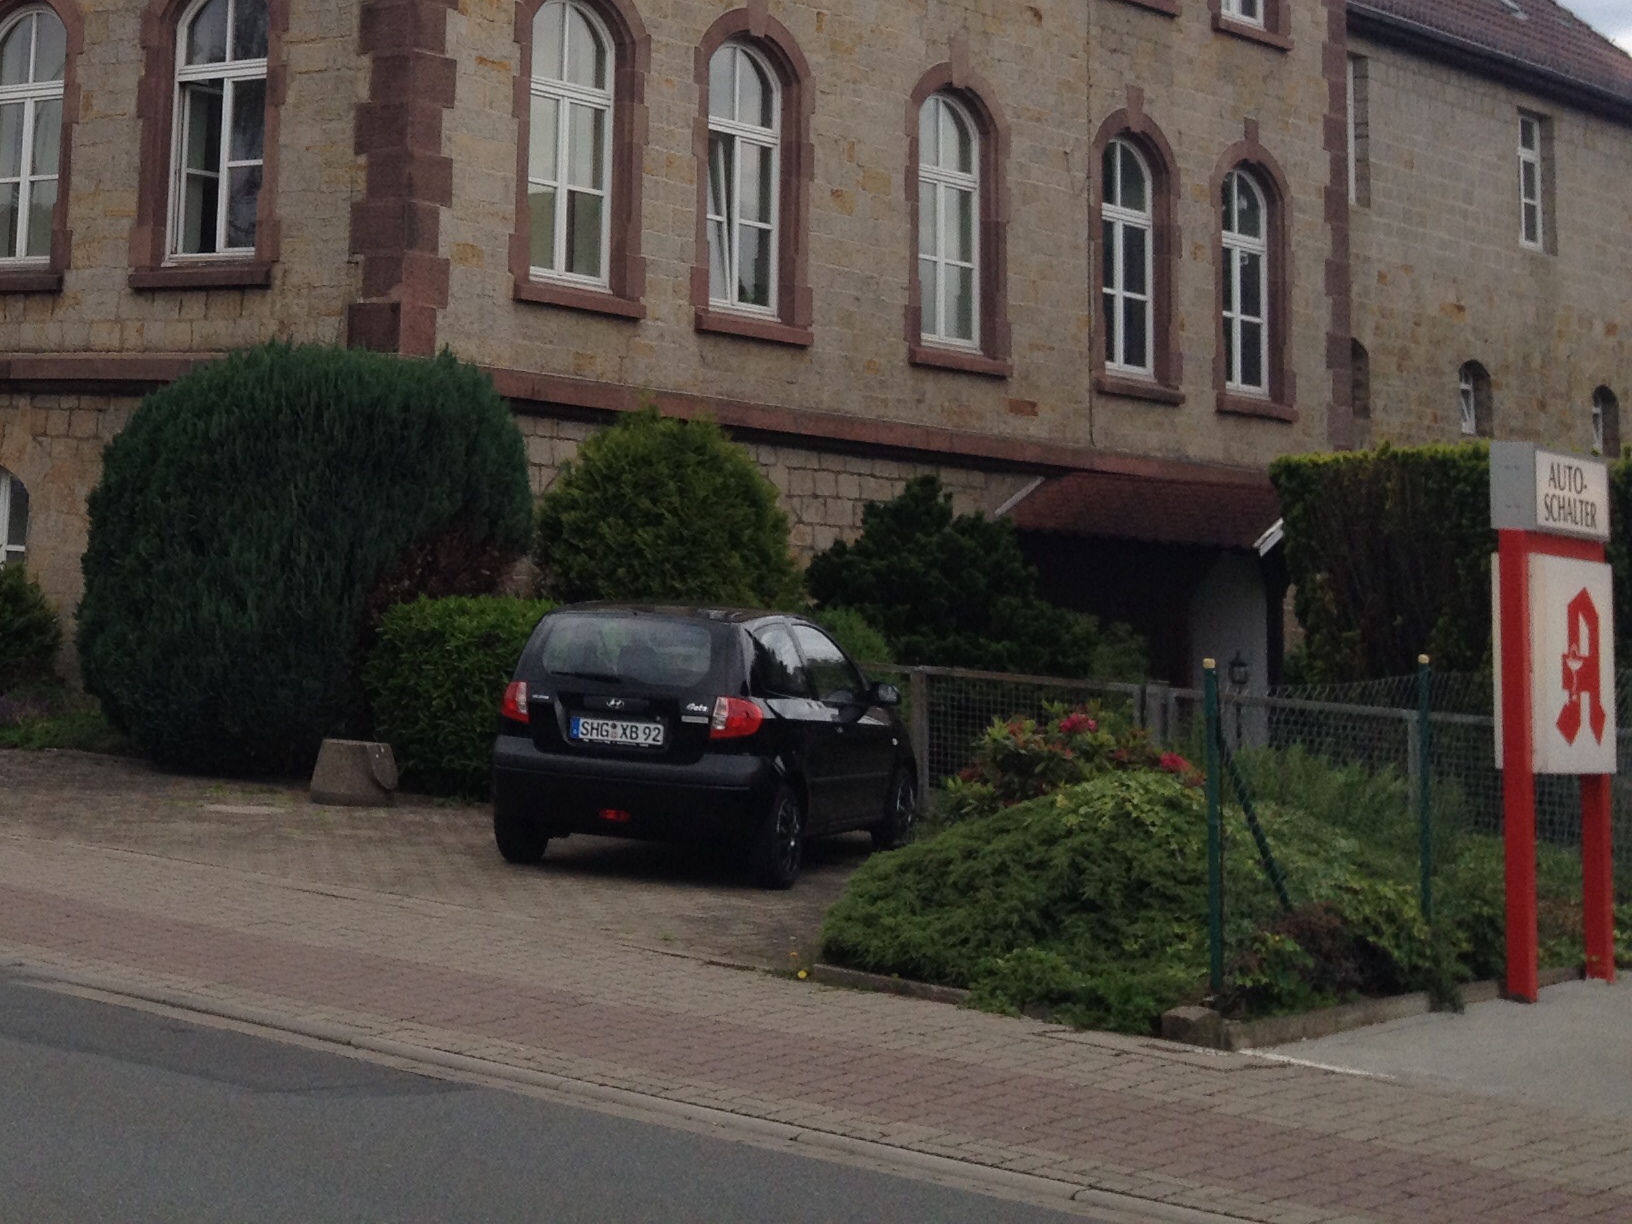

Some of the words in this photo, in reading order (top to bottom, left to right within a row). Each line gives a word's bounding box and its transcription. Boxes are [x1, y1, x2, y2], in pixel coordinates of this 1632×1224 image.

[1544, 492, 1598, 530] SCHALTER
[579, 720, 610, 740] SHG
[619, 724, 639, 741] XB
[643, 726, 662, 743] 92
